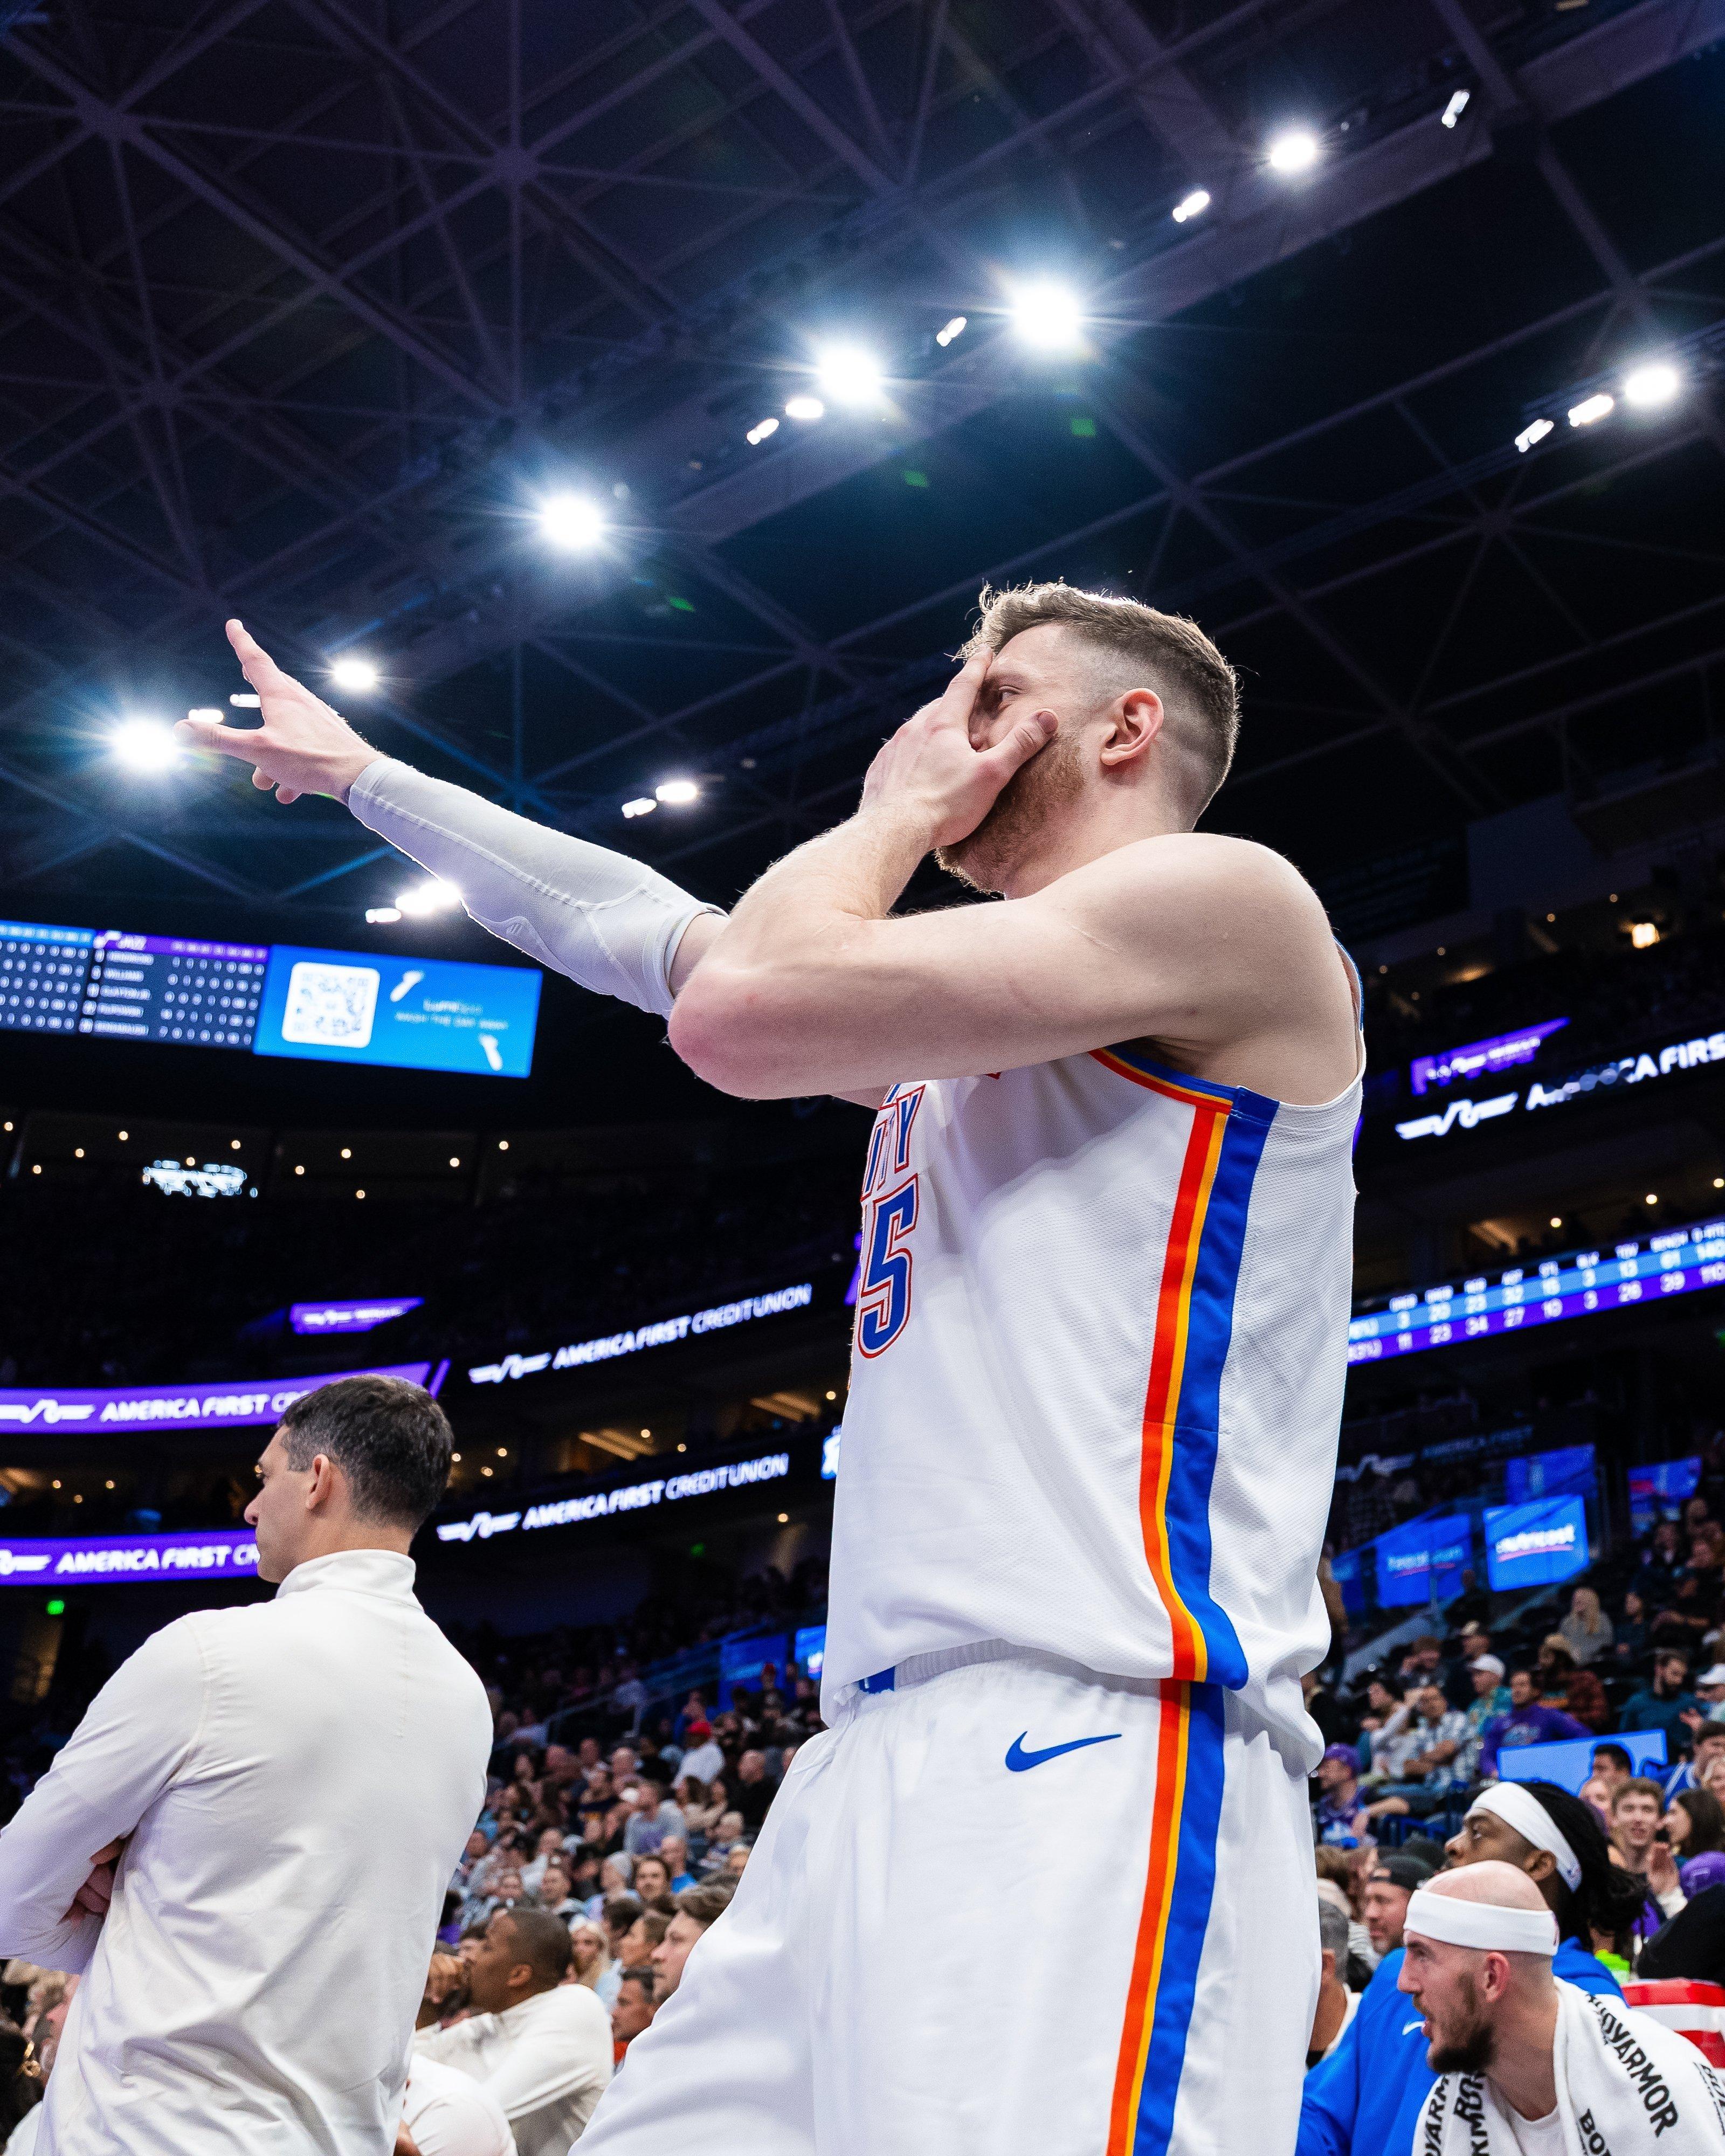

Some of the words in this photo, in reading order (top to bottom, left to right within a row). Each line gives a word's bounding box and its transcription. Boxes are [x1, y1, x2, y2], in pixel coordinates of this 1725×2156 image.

[552, 1331, 636, 1370] AMERICA
[636, 1315, 692, 1349] FIRST
[691, 1298, 754, 1333] CREDIT
[753, 1283, 812, 1317] UNION
[100, 1398, 200, 1422] AMERICA
[202, 1394, 270, 1418] FIRST
[522, 1493, 609, 1530] AMERICA
[608, 1480, 665, 1513] FIRST
[665, 1464, 730, 1500] CREDIT
[727, 1453, 789, 1487] UNION
[56, 1548, 160, 1574] AMERICA
[161, 1545, 232, 1570] FIRST
